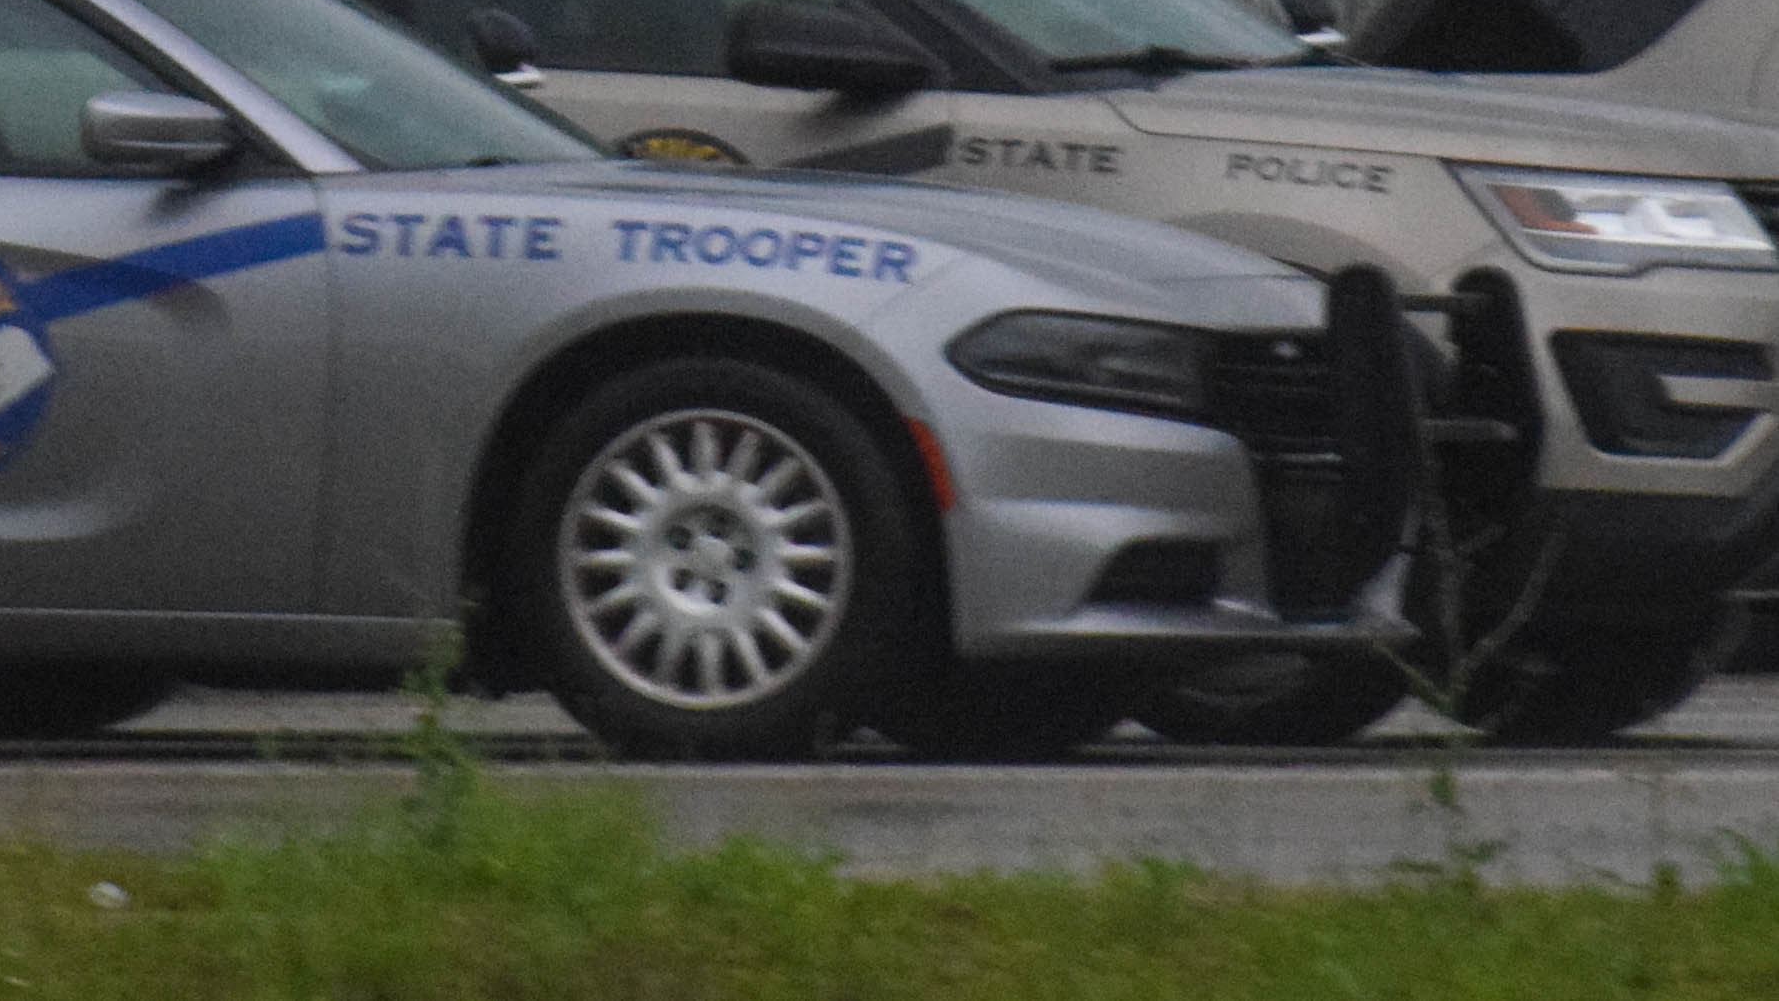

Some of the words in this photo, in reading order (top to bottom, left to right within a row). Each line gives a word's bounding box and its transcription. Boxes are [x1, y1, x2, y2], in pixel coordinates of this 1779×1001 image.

[958, 136, 1121, 175] STATE
[1226, 151, 1394, 195] POLICE
[339, 211, 563, 262] STATE
[614, 219, 918, 285] TROOPER
